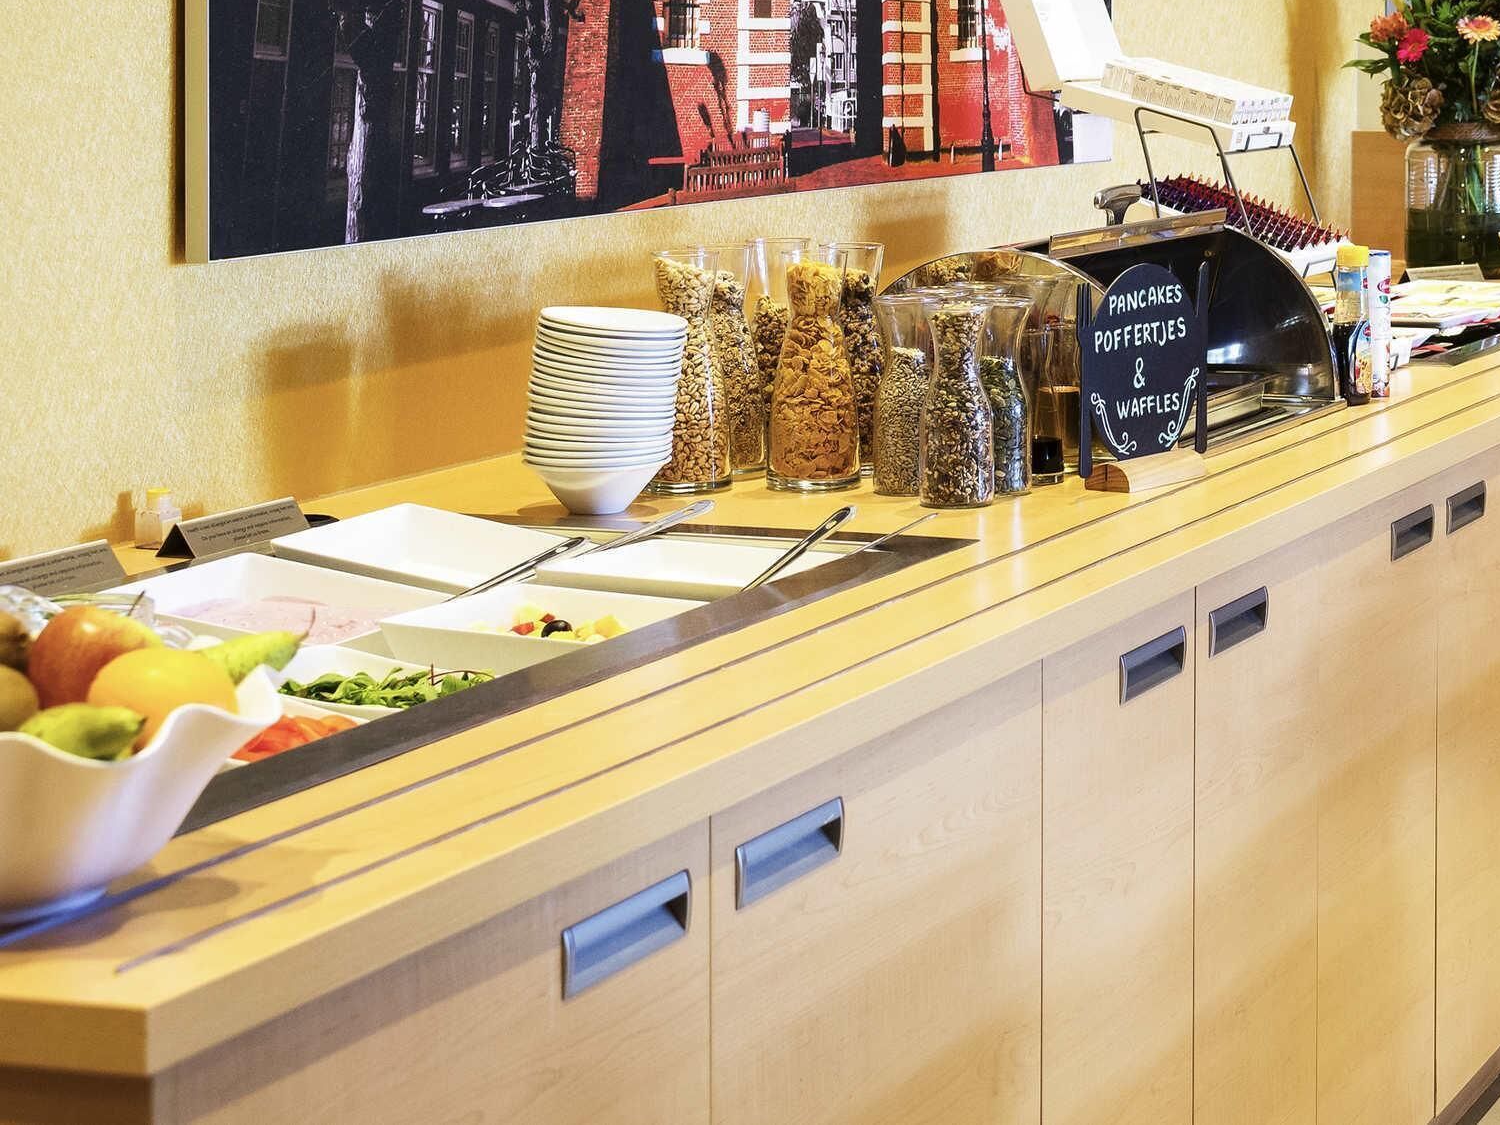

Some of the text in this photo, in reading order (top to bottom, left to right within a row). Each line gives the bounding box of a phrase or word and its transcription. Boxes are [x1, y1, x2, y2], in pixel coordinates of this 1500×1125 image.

[1108, 283, 1183, 317] PANCAKES
[1094, 317, 1187, 354] POFFERTJES
[1133, 357, 1146, 389] &
[1116, 392, 1180, 420] WAFFLES
